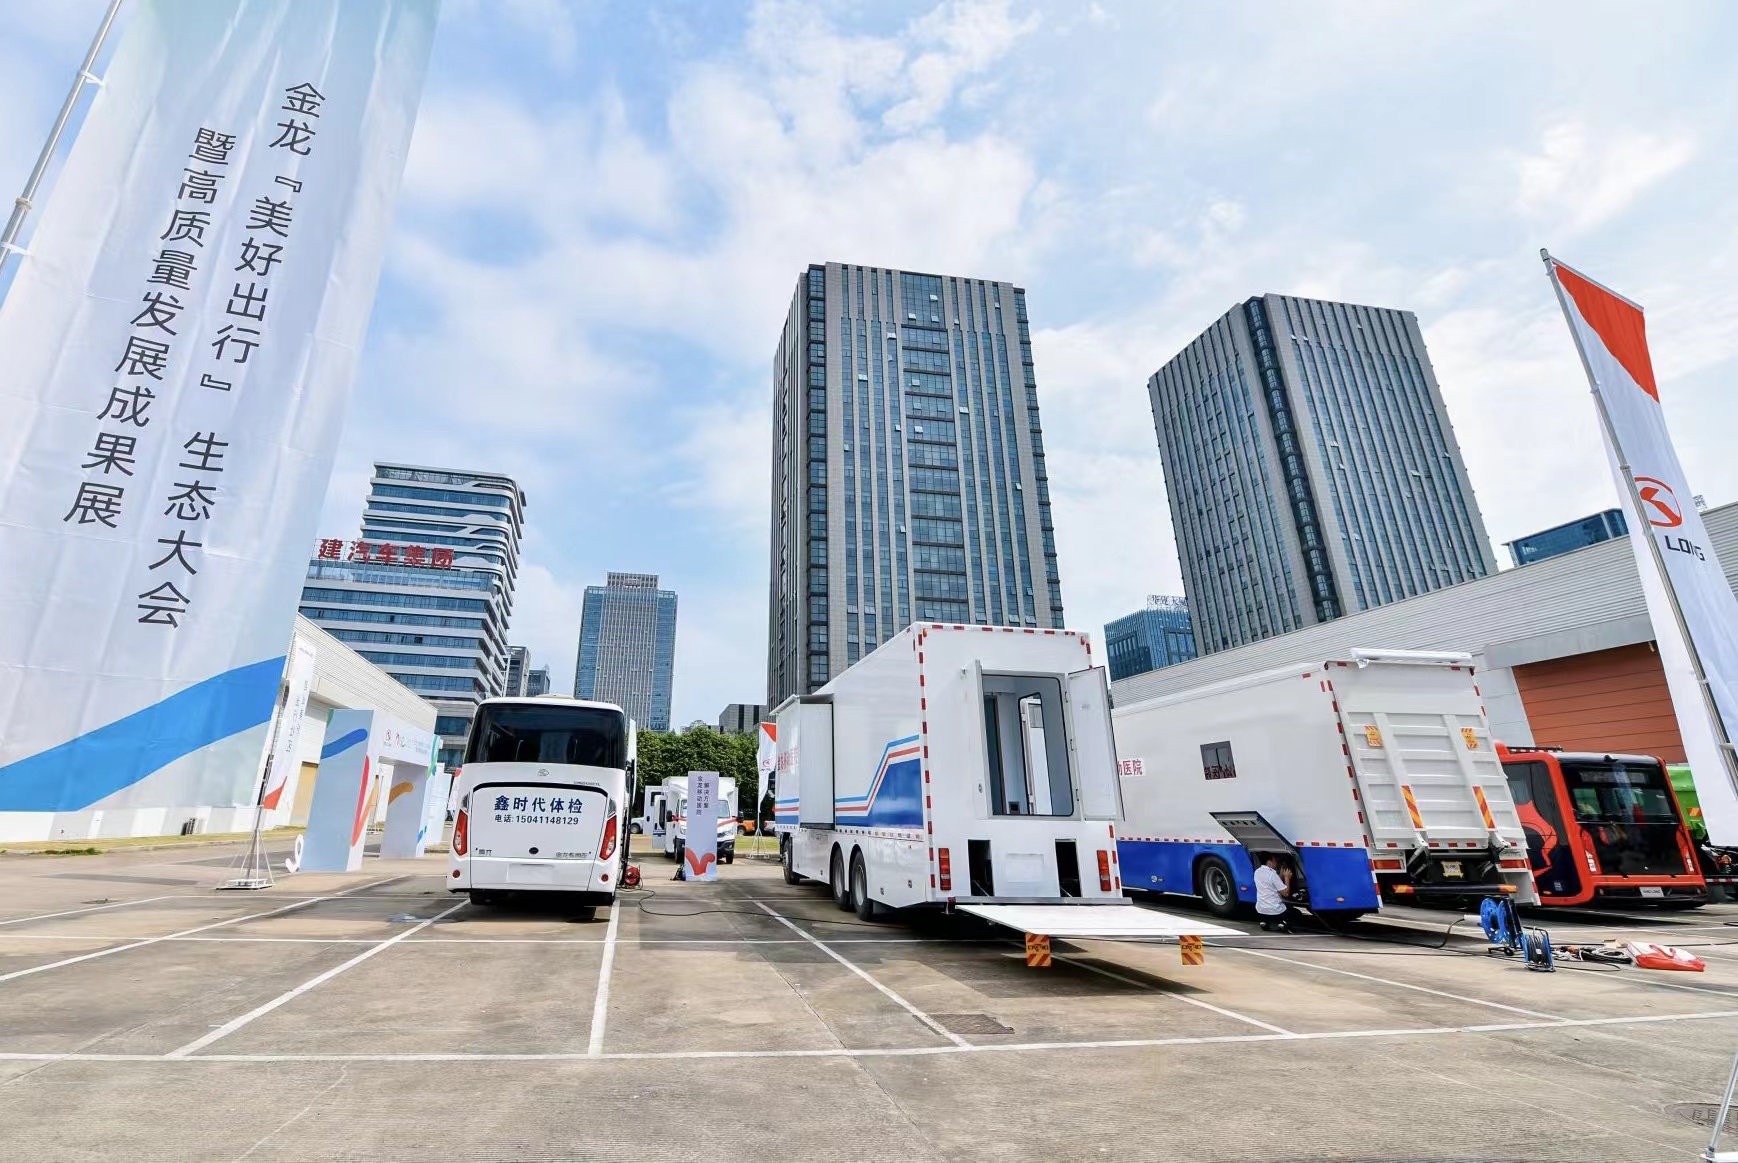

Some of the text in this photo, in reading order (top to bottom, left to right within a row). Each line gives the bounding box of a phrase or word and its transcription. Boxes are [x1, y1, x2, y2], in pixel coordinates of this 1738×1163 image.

[63, 127, 237, 528] 暨高质量发展成果展
[494, 795, 583, 814] 鑫时代体检
